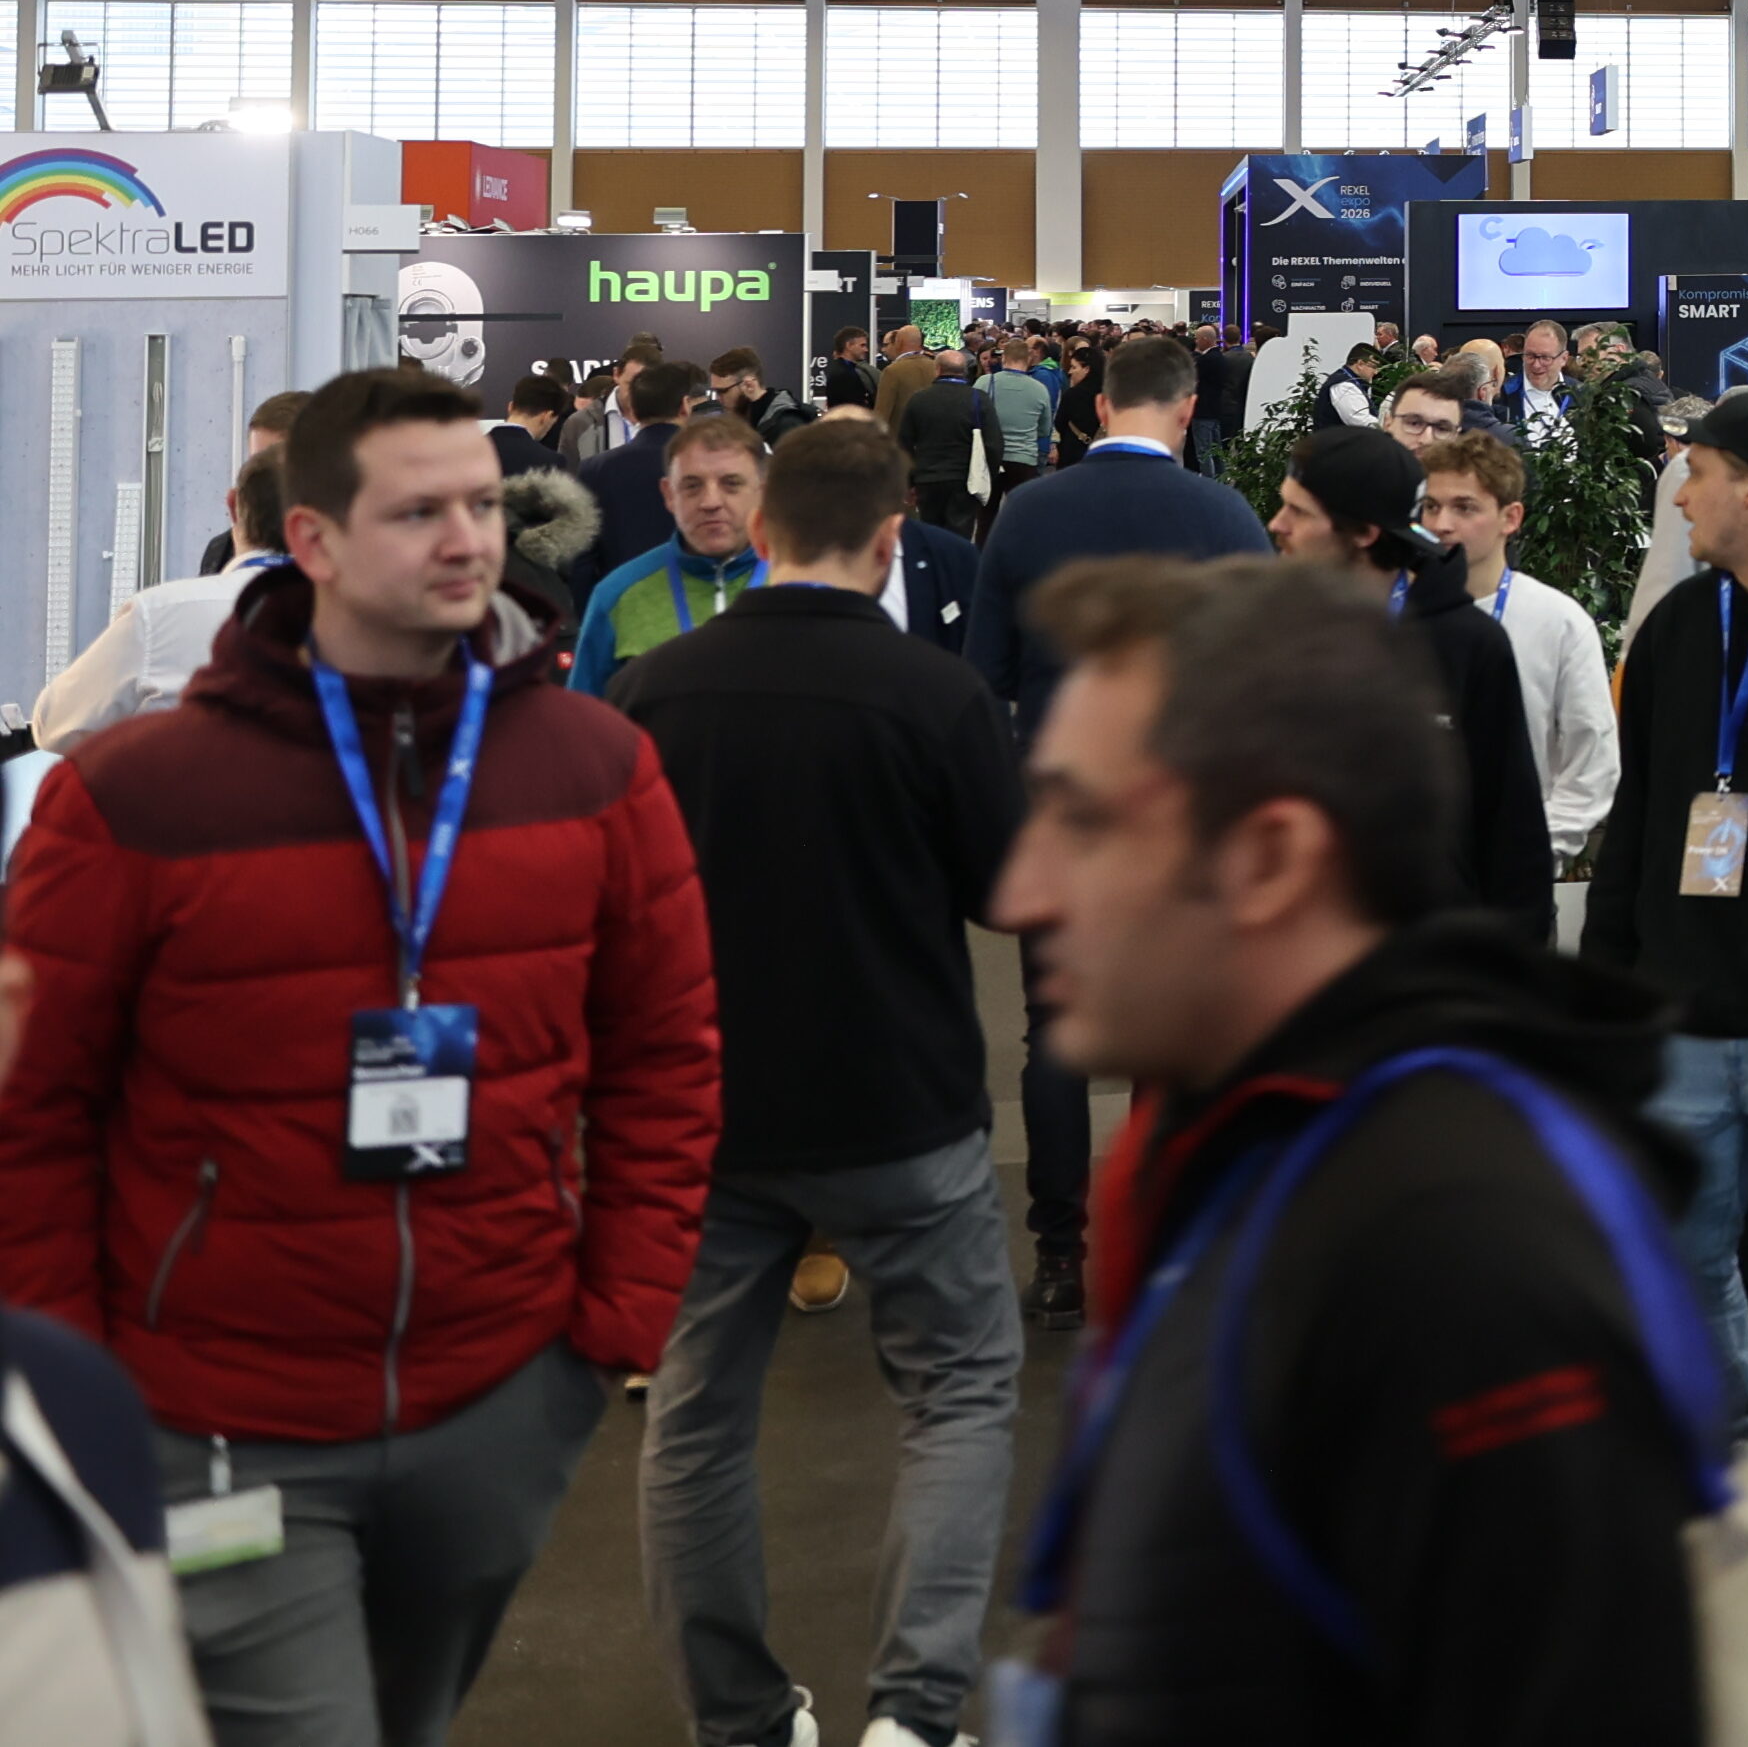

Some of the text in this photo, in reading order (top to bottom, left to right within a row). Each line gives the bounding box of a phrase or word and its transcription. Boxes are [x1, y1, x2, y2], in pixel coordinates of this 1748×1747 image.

[1340, 185, 1370, 196] REXEL
[1340, 197, 1371, 208] expo
[1341, 209, 1371, 219] 2026
[11, 221, 255, 262] SpektraLED
[1272, 257, 1289, 266] Die
[1291, 257, 1321, 265] REXEL
[1322, 256, 1400, 265] Themenwelten
[11, 261, 254, 277] MEHR LICHT FÜR WENIGER ENERGIE
[589, 261, 770, 312] haupa
[1678, 304, 1740, 318] SMART
